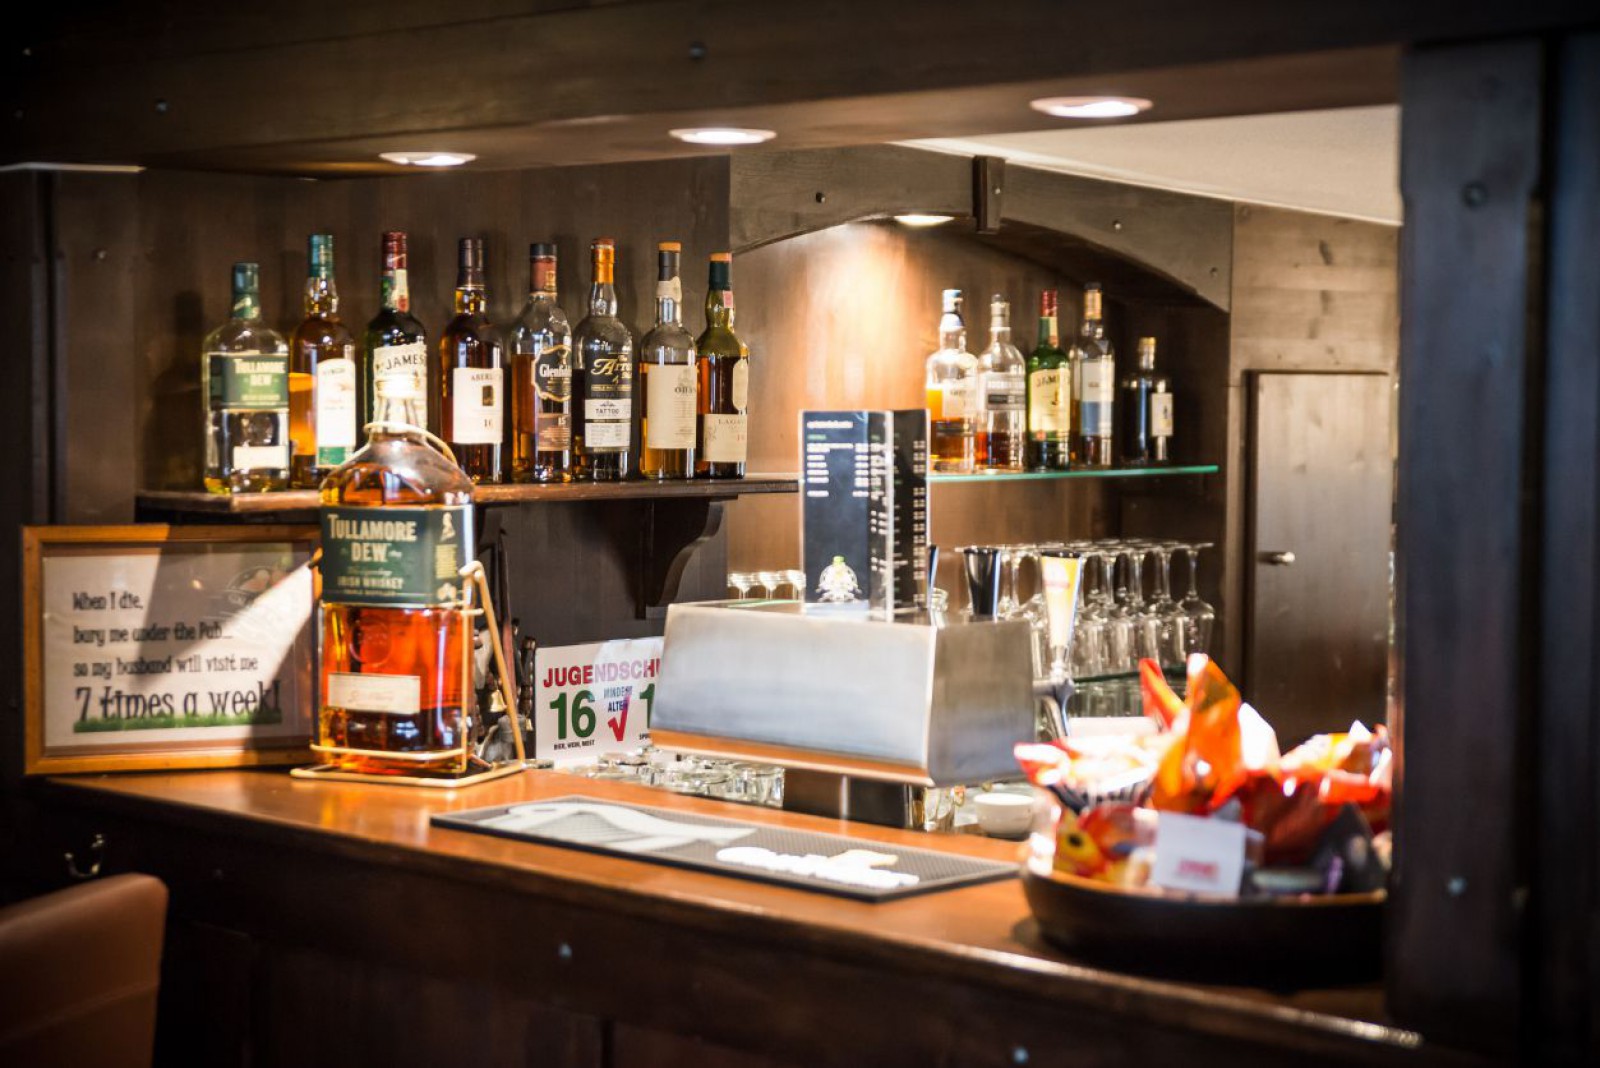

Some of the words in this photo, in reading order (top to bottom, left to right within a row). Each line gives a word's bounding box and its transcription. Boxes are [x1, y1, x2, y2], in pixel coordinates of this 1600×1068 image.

[327, 514, 418, 541] TULLAMORE
[352, 542, 389, 562] DEW
[72, 591, 107, 611] When
[111, 592, 116, 610] I
[73, 624, 106, 647] bury
[109, 627, 129, 643] me
[133, 623, 169, 642] under
[173, 621, 195, 641] the
[73, 661, 88, 677] so
[92, 660, 112, 679] my
[116, 655, 172, 675] husband
[175, 654, 202, 673] will
[206, 654, 237, 672] visit
[240, 656, 259, 671] me
[75, 687, 92, 721] 7
[99, 686, 174, 720] times
[183, 691, 198, 717] a
[209, 680, 281, 716] week!
[549, 690, 596, 741] 16
